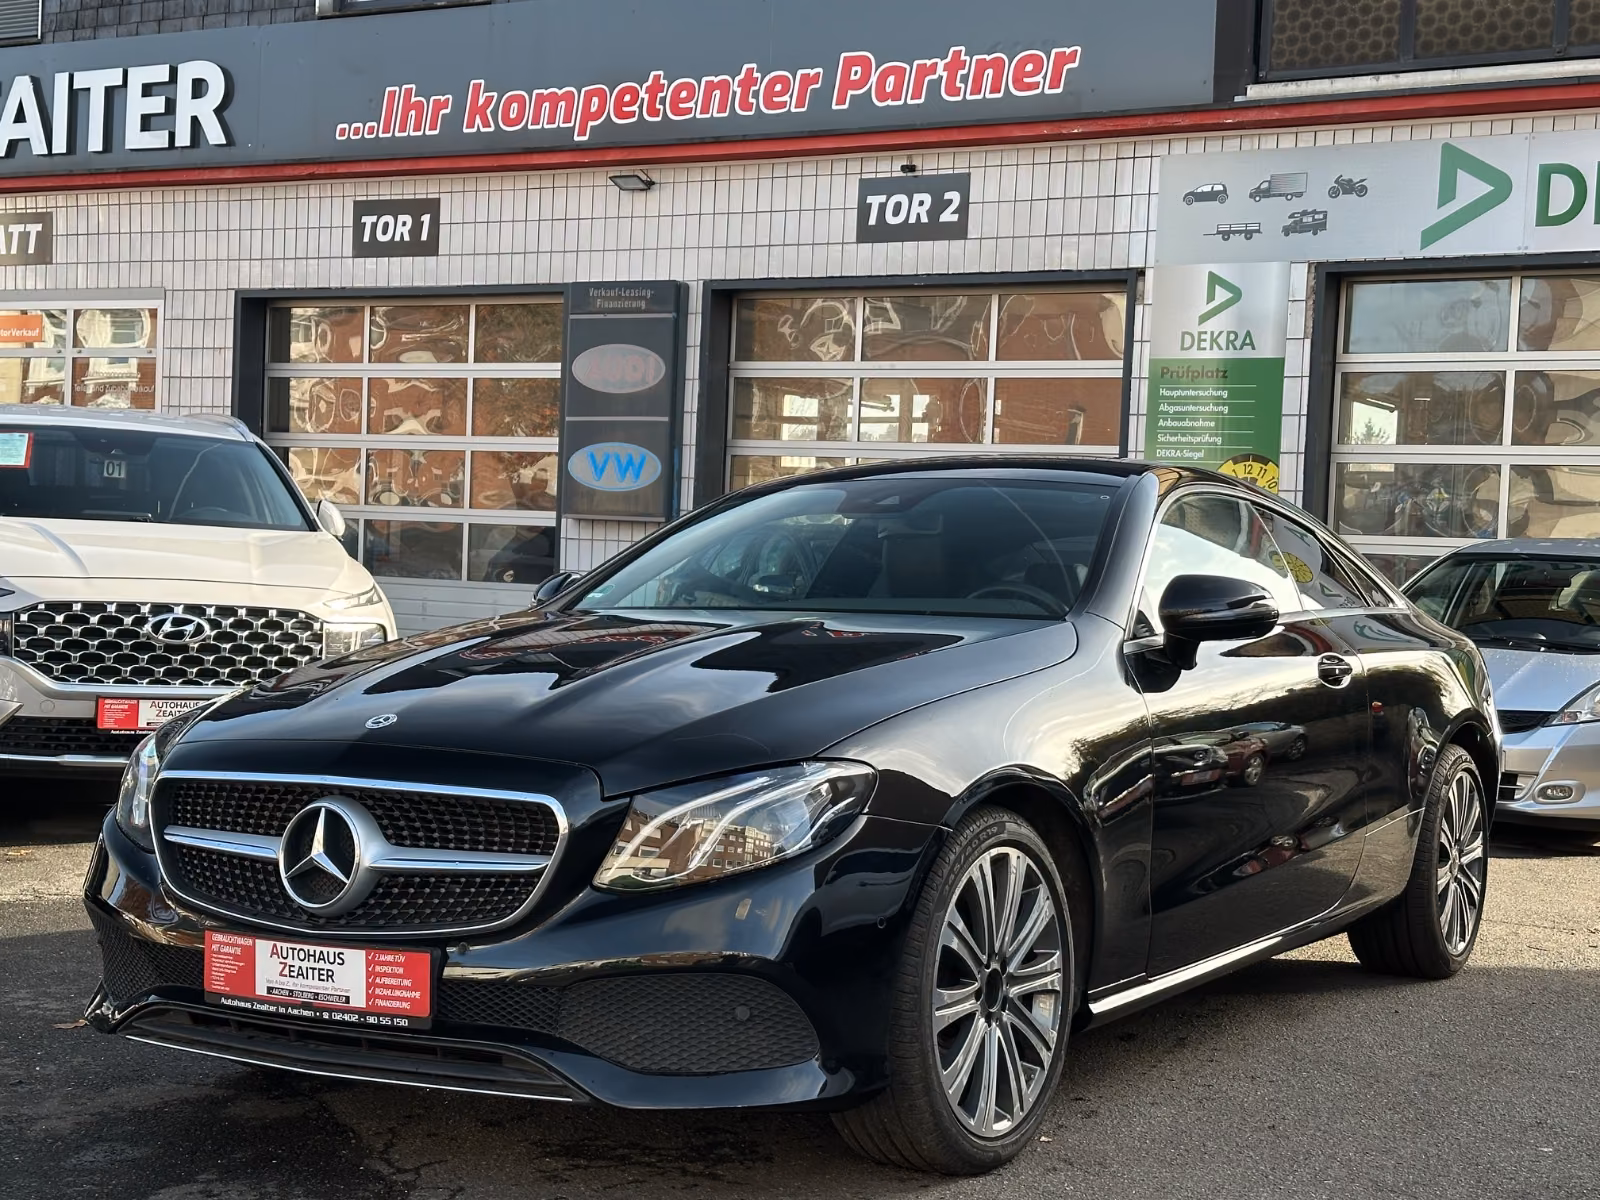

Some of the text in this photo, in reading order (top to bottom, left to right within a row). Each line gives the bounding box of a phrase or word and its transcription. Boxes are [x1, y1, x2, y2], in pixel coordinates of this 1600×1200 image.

[463, 67, 823, 141] kompetenter
[831, 45, 1082, 110] Partner
[1534, 162, 1600, 228] D
[865, 191, 961, 226] TOR 2
[360, 213, 431, 243] TOR 1
[596, 298, 646, 310] Finanzierung
[1180, 330, 1256, 351] DEKRA
[1160, 365, 1229, 382] Prüfplatz
[1159, 387, 1229, 399] Hauptuntersuchung
[1158, 403, 1229, 414] Abgasuntersuchung
[1157, 418, 1216, 428] Anbauabnahme
[1157, 433, 1222, 445] Sicherheitsprüfung
[1156, 449, 1205, 460] DEKRA-Siegel
[106, 461, 122, 476] 01
[588, 452, 647, 482] VW
[1243, 464, 1253, 475] 12
[1257, 466, 1267, 479] 11
[1266, 476, 1278, 490] 10
[980, 826, 998, 841] R19
[270, 943, 345, 966] AUTOHAUS
[279, 962, 335, 983] ZEAITER
[220, 997, 251, 1008] Autohaus
[252, 1003, 277, 1012] Zeaiter
[279, 1005, 286, 1013] in
[287, 1007, 315, 1017] Aachen
[332, 1013, 359, 1023] 02402
[393, 1018, 409, 1027] 150
